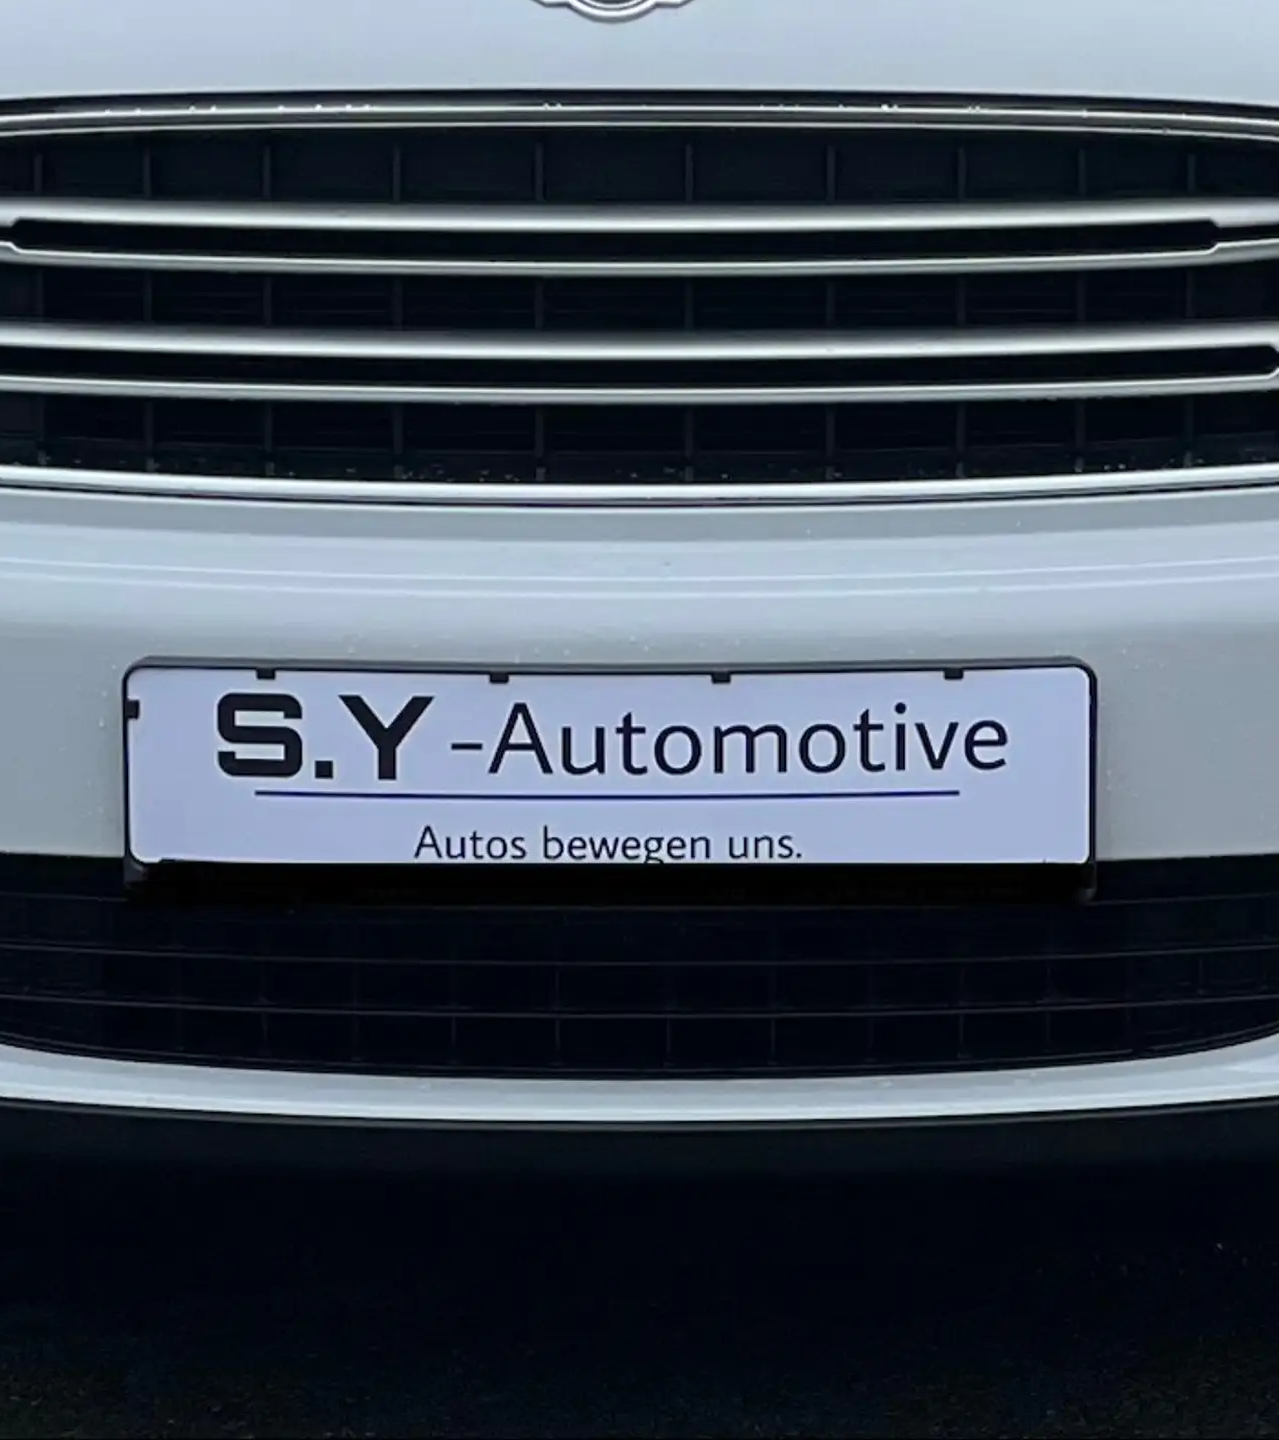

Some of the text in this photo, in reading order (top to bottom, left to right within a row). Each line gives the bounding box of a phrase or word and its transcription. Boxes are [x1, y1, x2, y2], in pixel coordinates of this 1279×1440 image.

[216, 692, 434, 781] S.Y
[413, 824, 802, 863] Autos bewegen uns.
